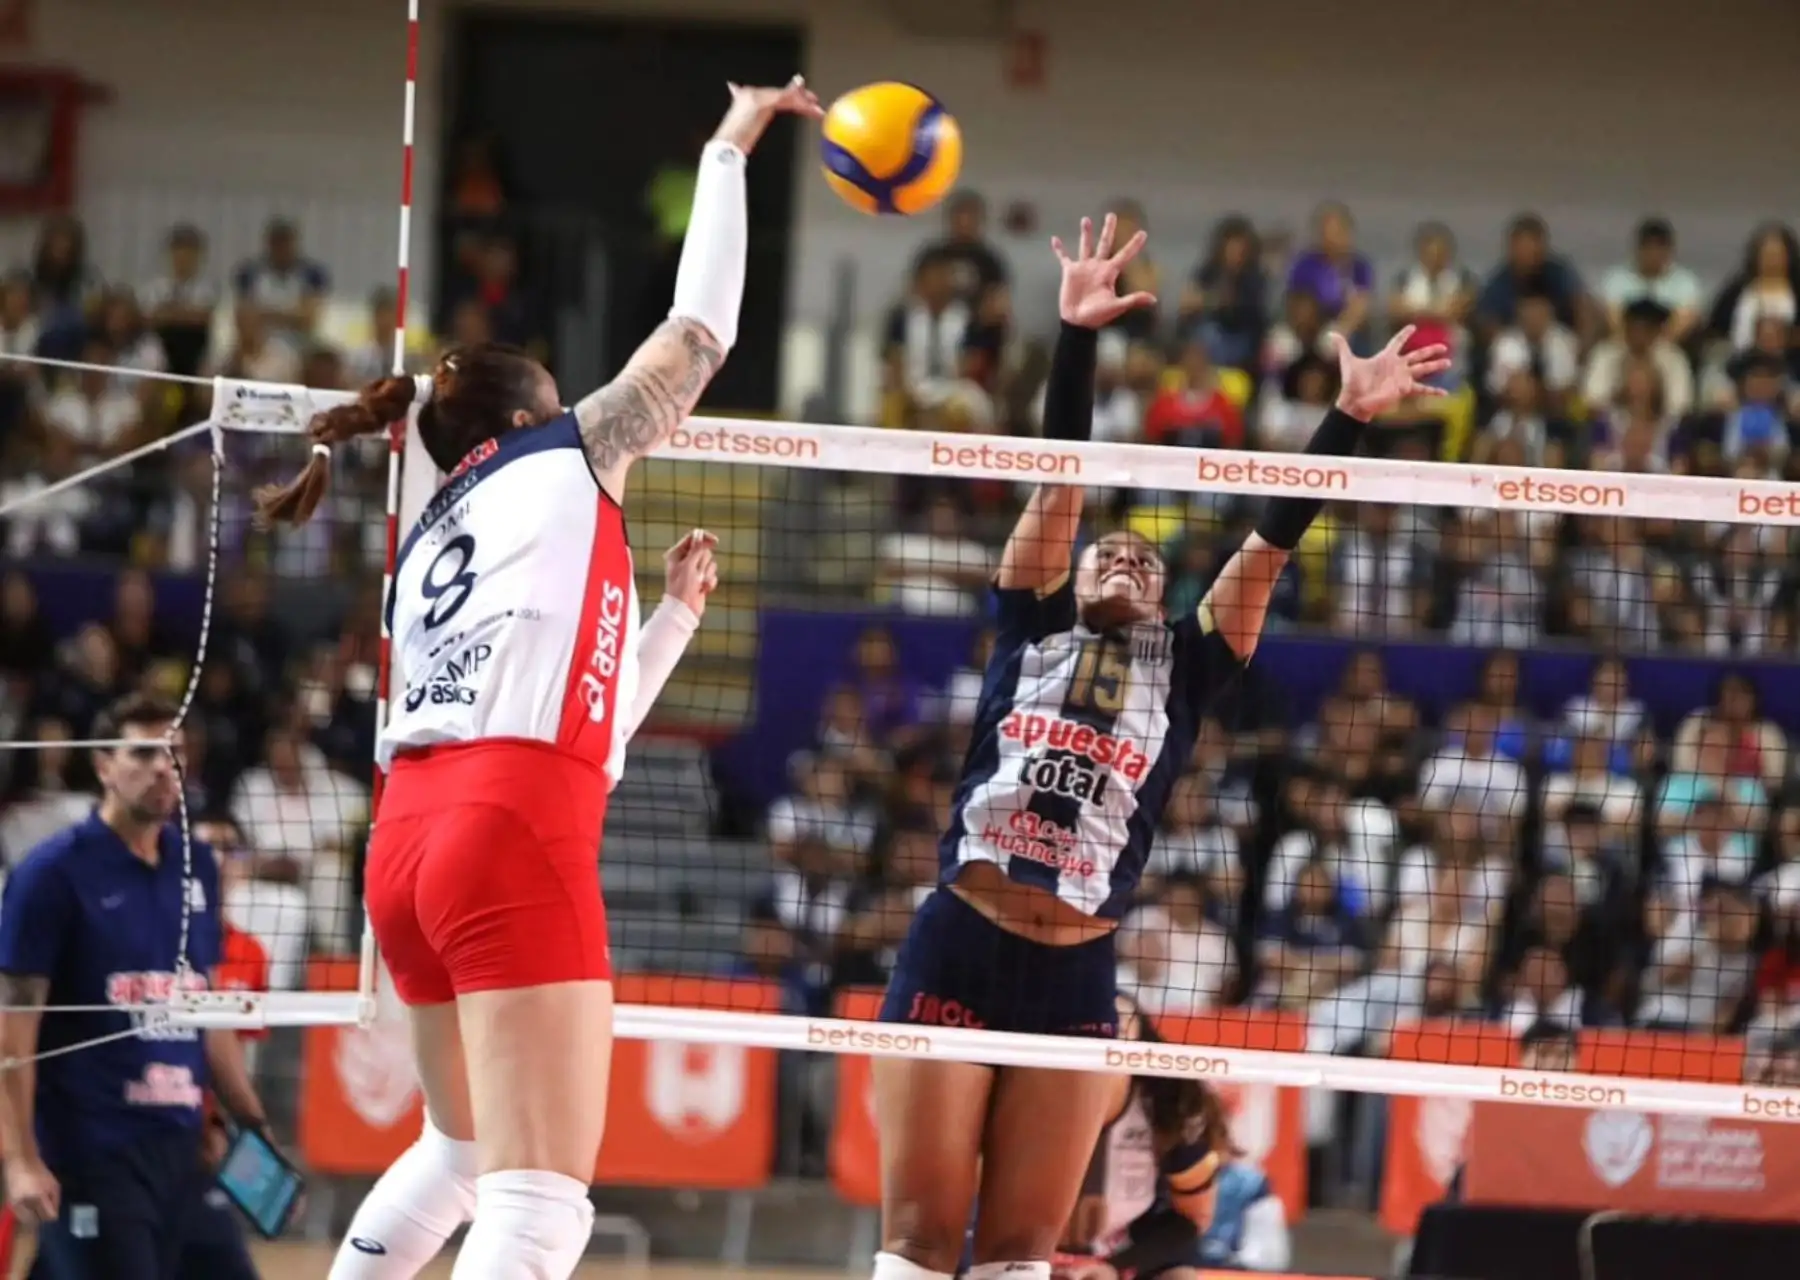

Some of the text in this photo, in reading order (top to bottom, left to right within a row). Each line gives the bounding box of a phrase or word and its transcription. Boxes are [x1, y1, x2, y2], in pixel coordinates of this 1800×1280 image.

[670, 427, 818, 458] betsson
[931, 441, 1082, 475] betsson
[1197, 456, 1348, 490] betsson
[1498, 476, 1624, 507] etsson
[421, 534, 478, 632] 8
[591, 580, 624, 677] asics
[1068, 642, 1134, 711] 15
[1001, 711, 1150, 780] apuesta
[1020, 754, 1110, 806] total
[984, 824, 1094, 878] Huancayo
[807, 1024, 932, 1053] betsson
[1105, 1046, 1229, 1075] betsson
[1500, 1075, 1626, 1105] betsson
[1743, 1093, 1800, 1117] bet
